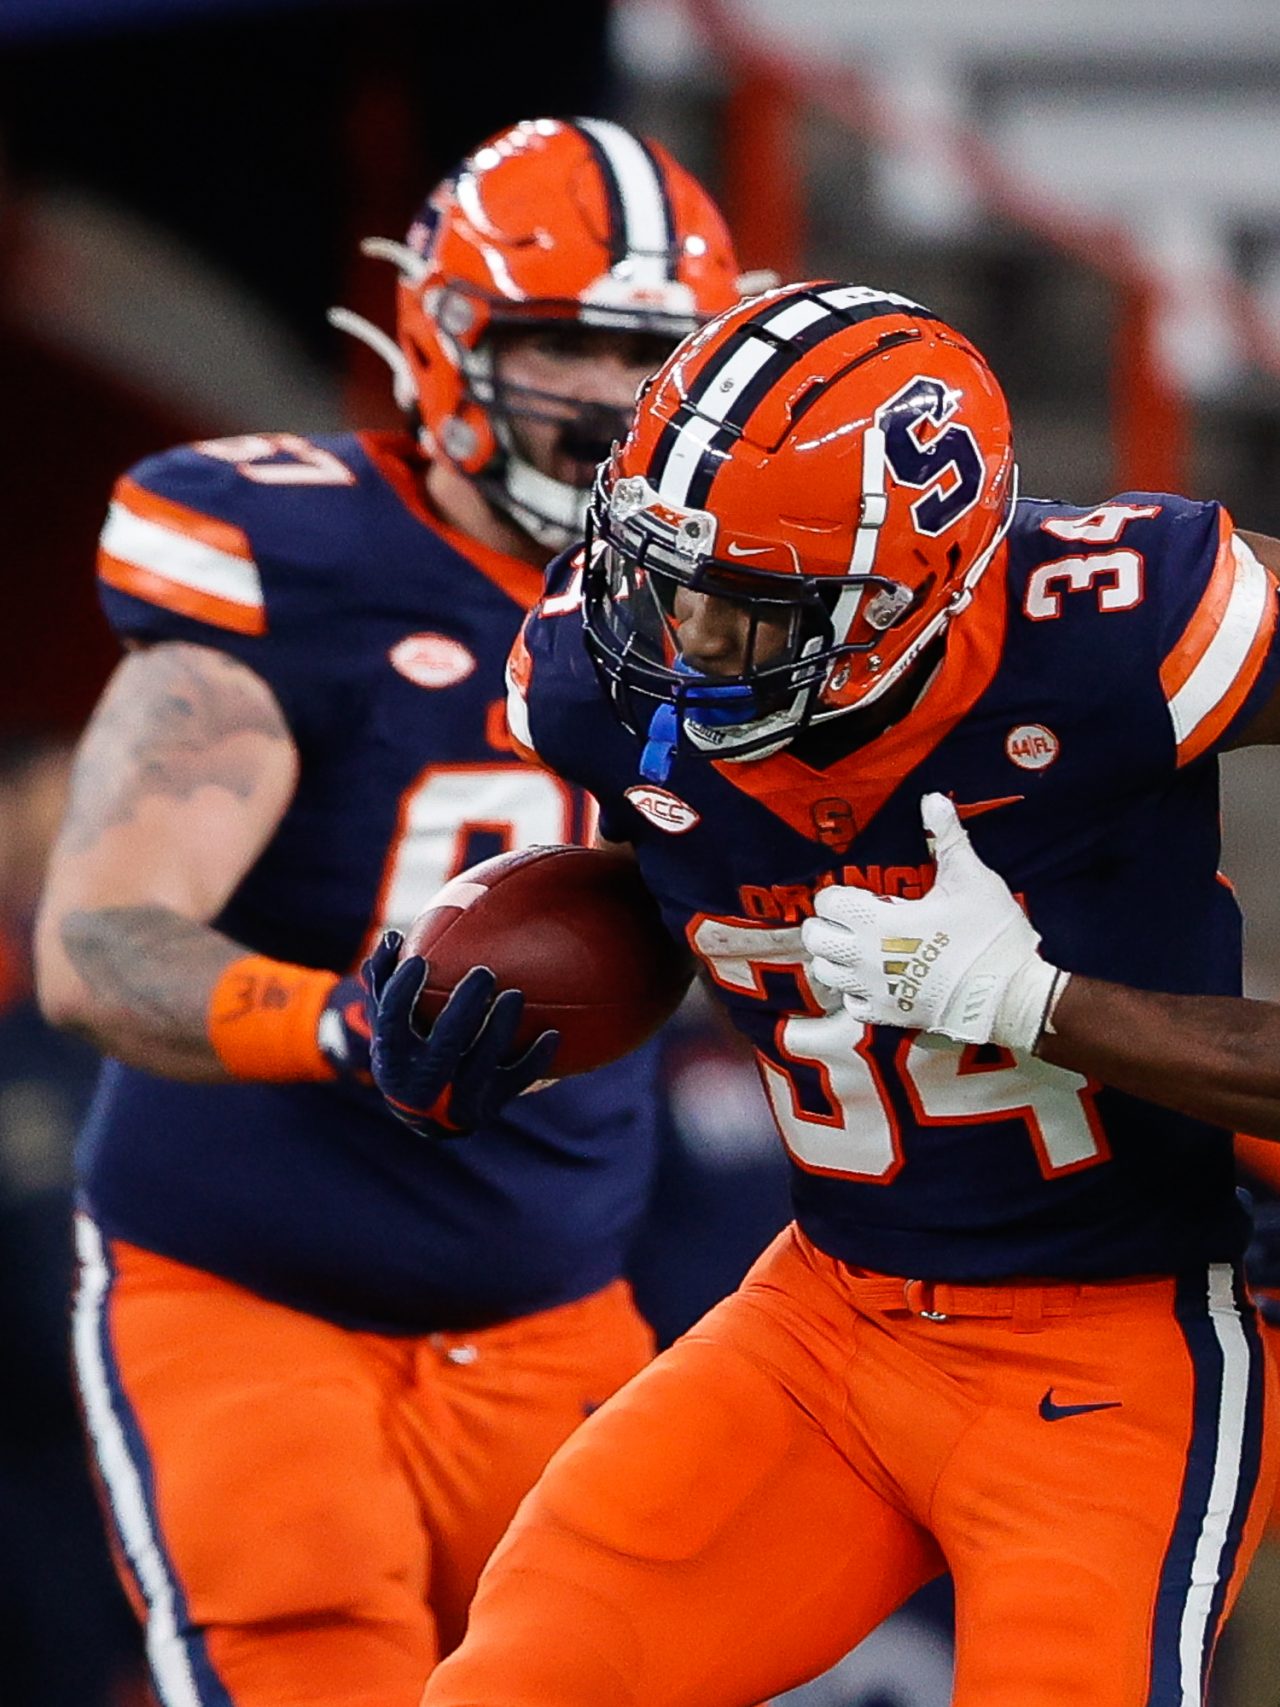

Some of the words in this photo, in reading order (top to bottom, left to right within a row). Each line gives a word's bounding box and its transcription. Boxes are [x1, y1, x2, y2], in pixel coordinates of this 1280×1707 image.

[874, 375, 986, 538] S
[1022, 501, 1164, 622] 34
[637, 797, 686, 821] ACC
[897, 931, 951, 1012] adidas
[685, 893, 1113, 1187] 34
